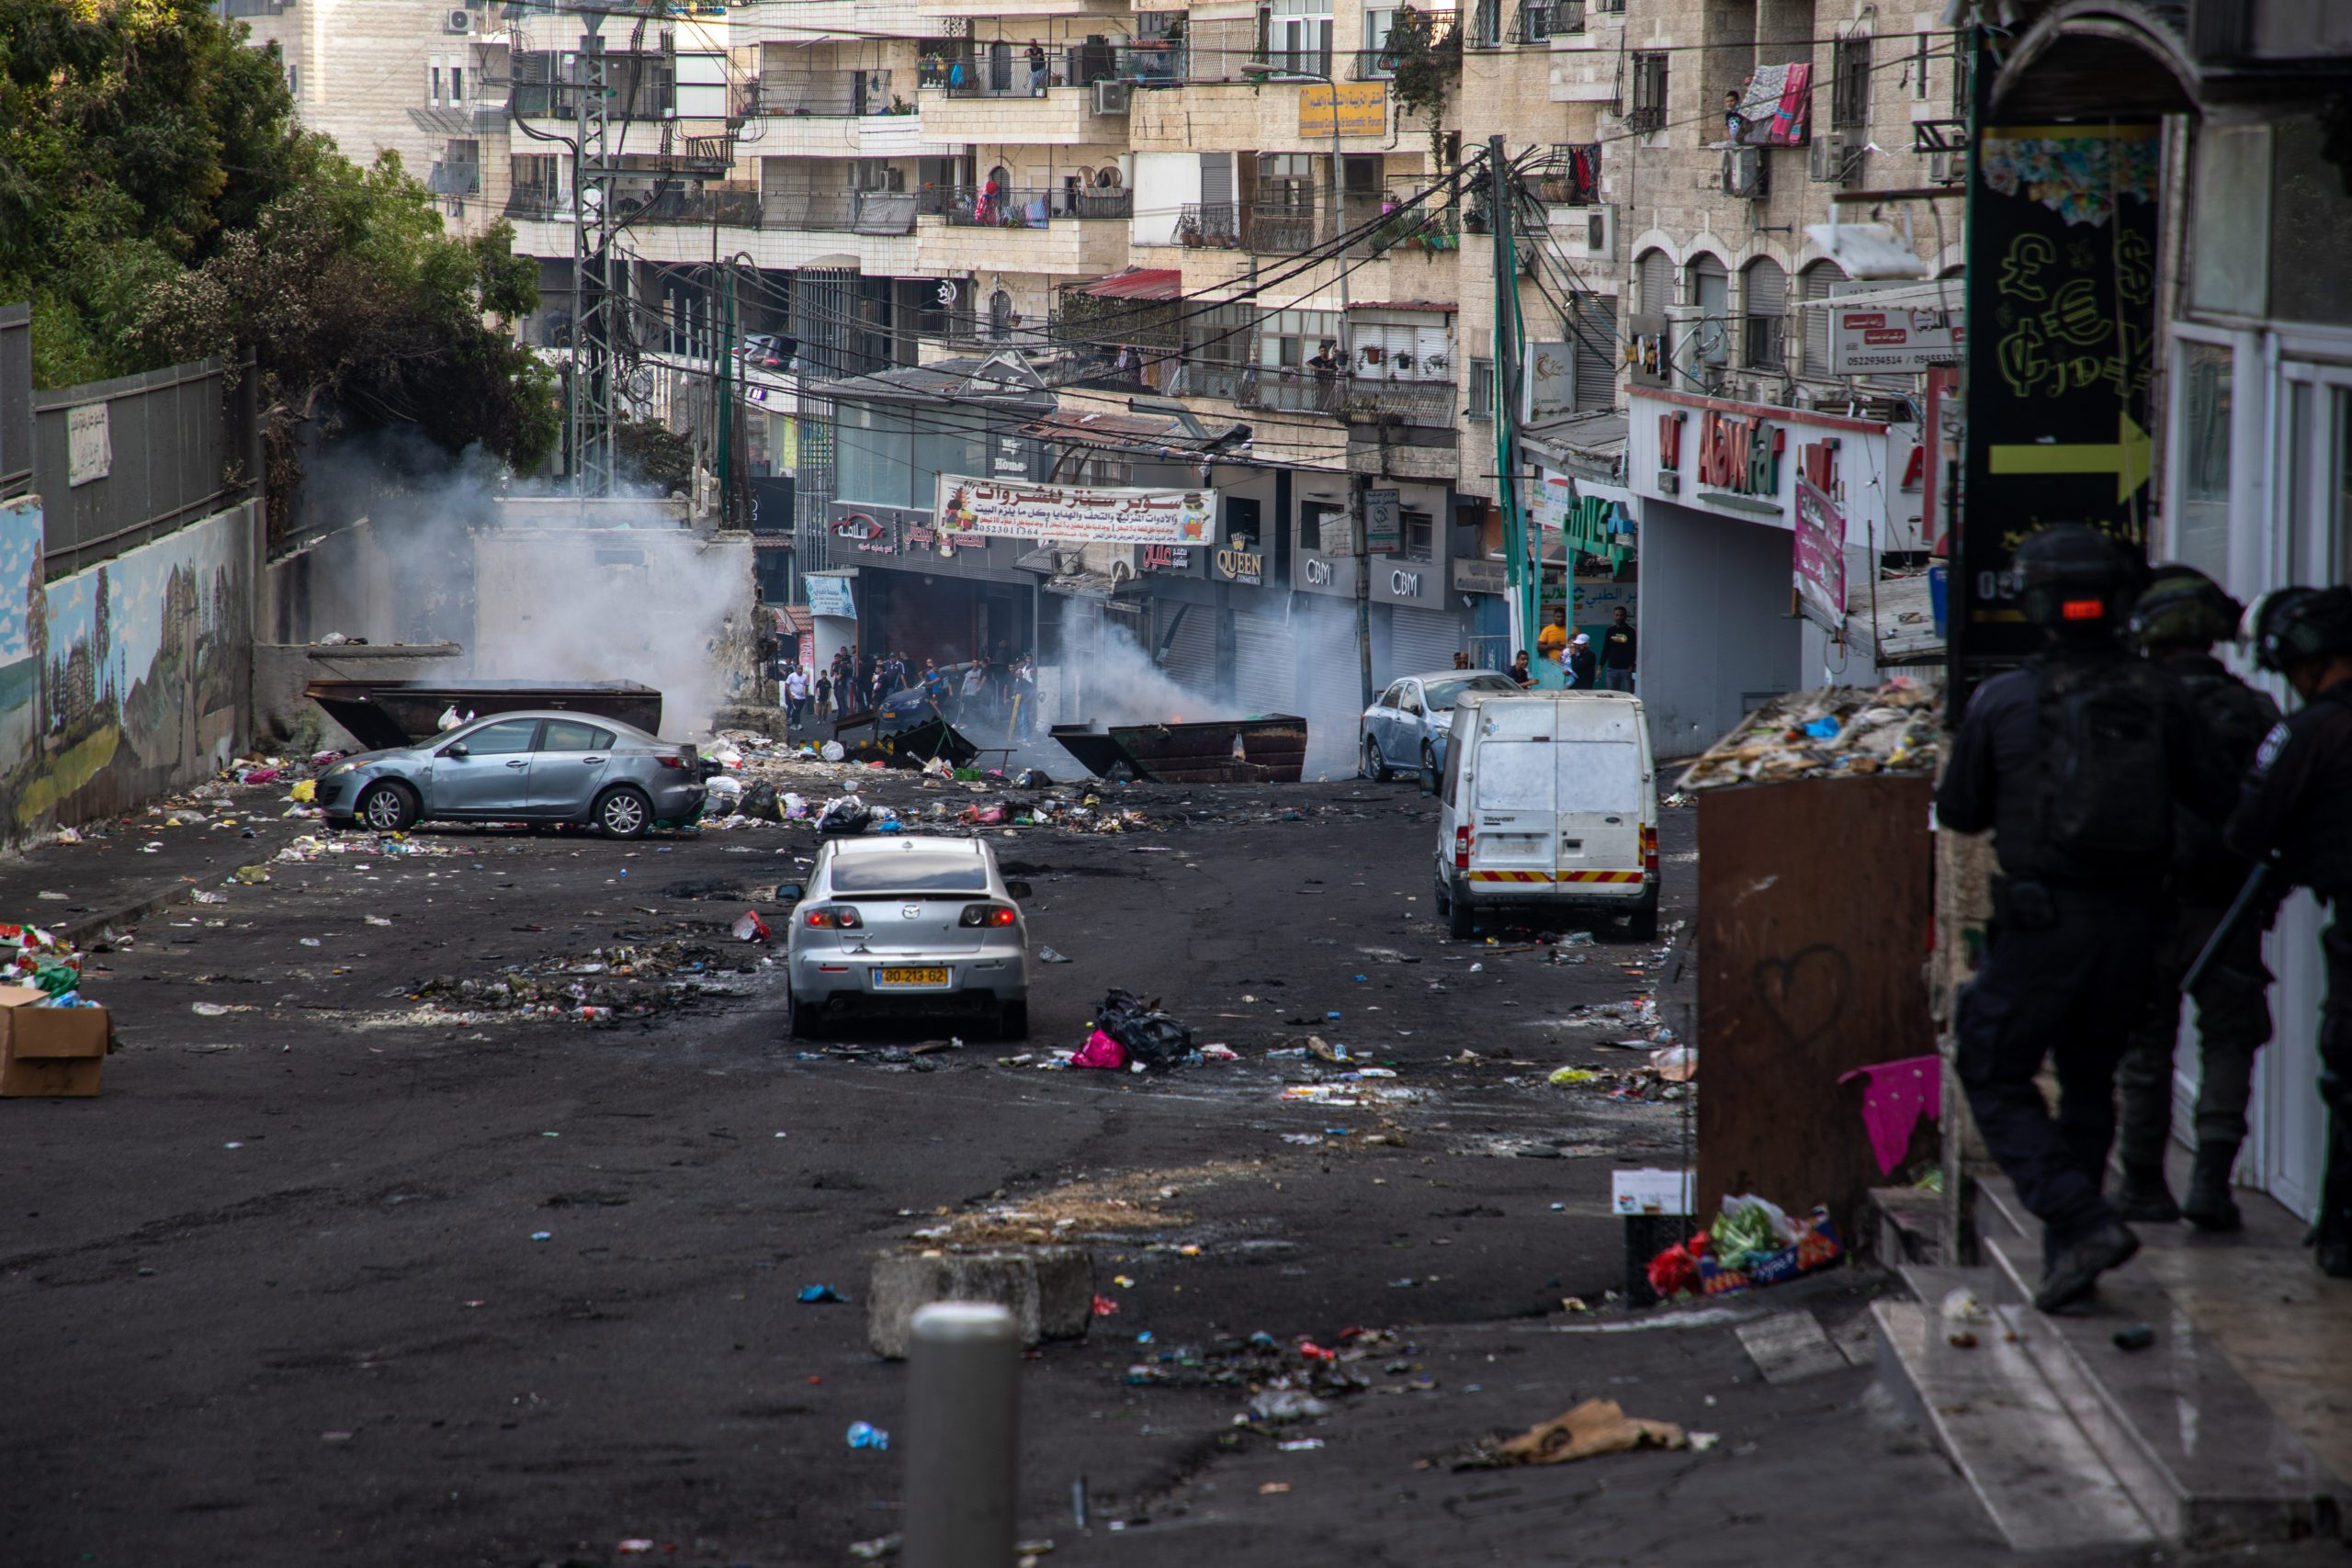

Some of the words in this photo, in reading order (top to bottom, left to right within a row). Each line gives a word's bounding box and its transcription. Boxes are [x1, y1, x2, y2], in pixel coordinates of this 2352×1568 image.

[994, 457, 1027, 472] Home
[975, 504, 997, 513] البيت
[1066, 490, 1117, 509] سنتر
[1120, 495, 1182, 513] سوبر
[1028, 509, 1051, 520] وكل
[1052, 511, 1082, 521] والهدايا
[838, 517, 868, 540] سلامة
[979, 525, 1038, 535] 0523011364
[1216, 549, 1261, 579] QUEEN
[1306, 558, 1330, 586] CBM
[1237, 574, 1261, 585] COSMETICS
[1391, 570, 1418, 597] CBM
[1586, 587, 1623, 609] الطبي
